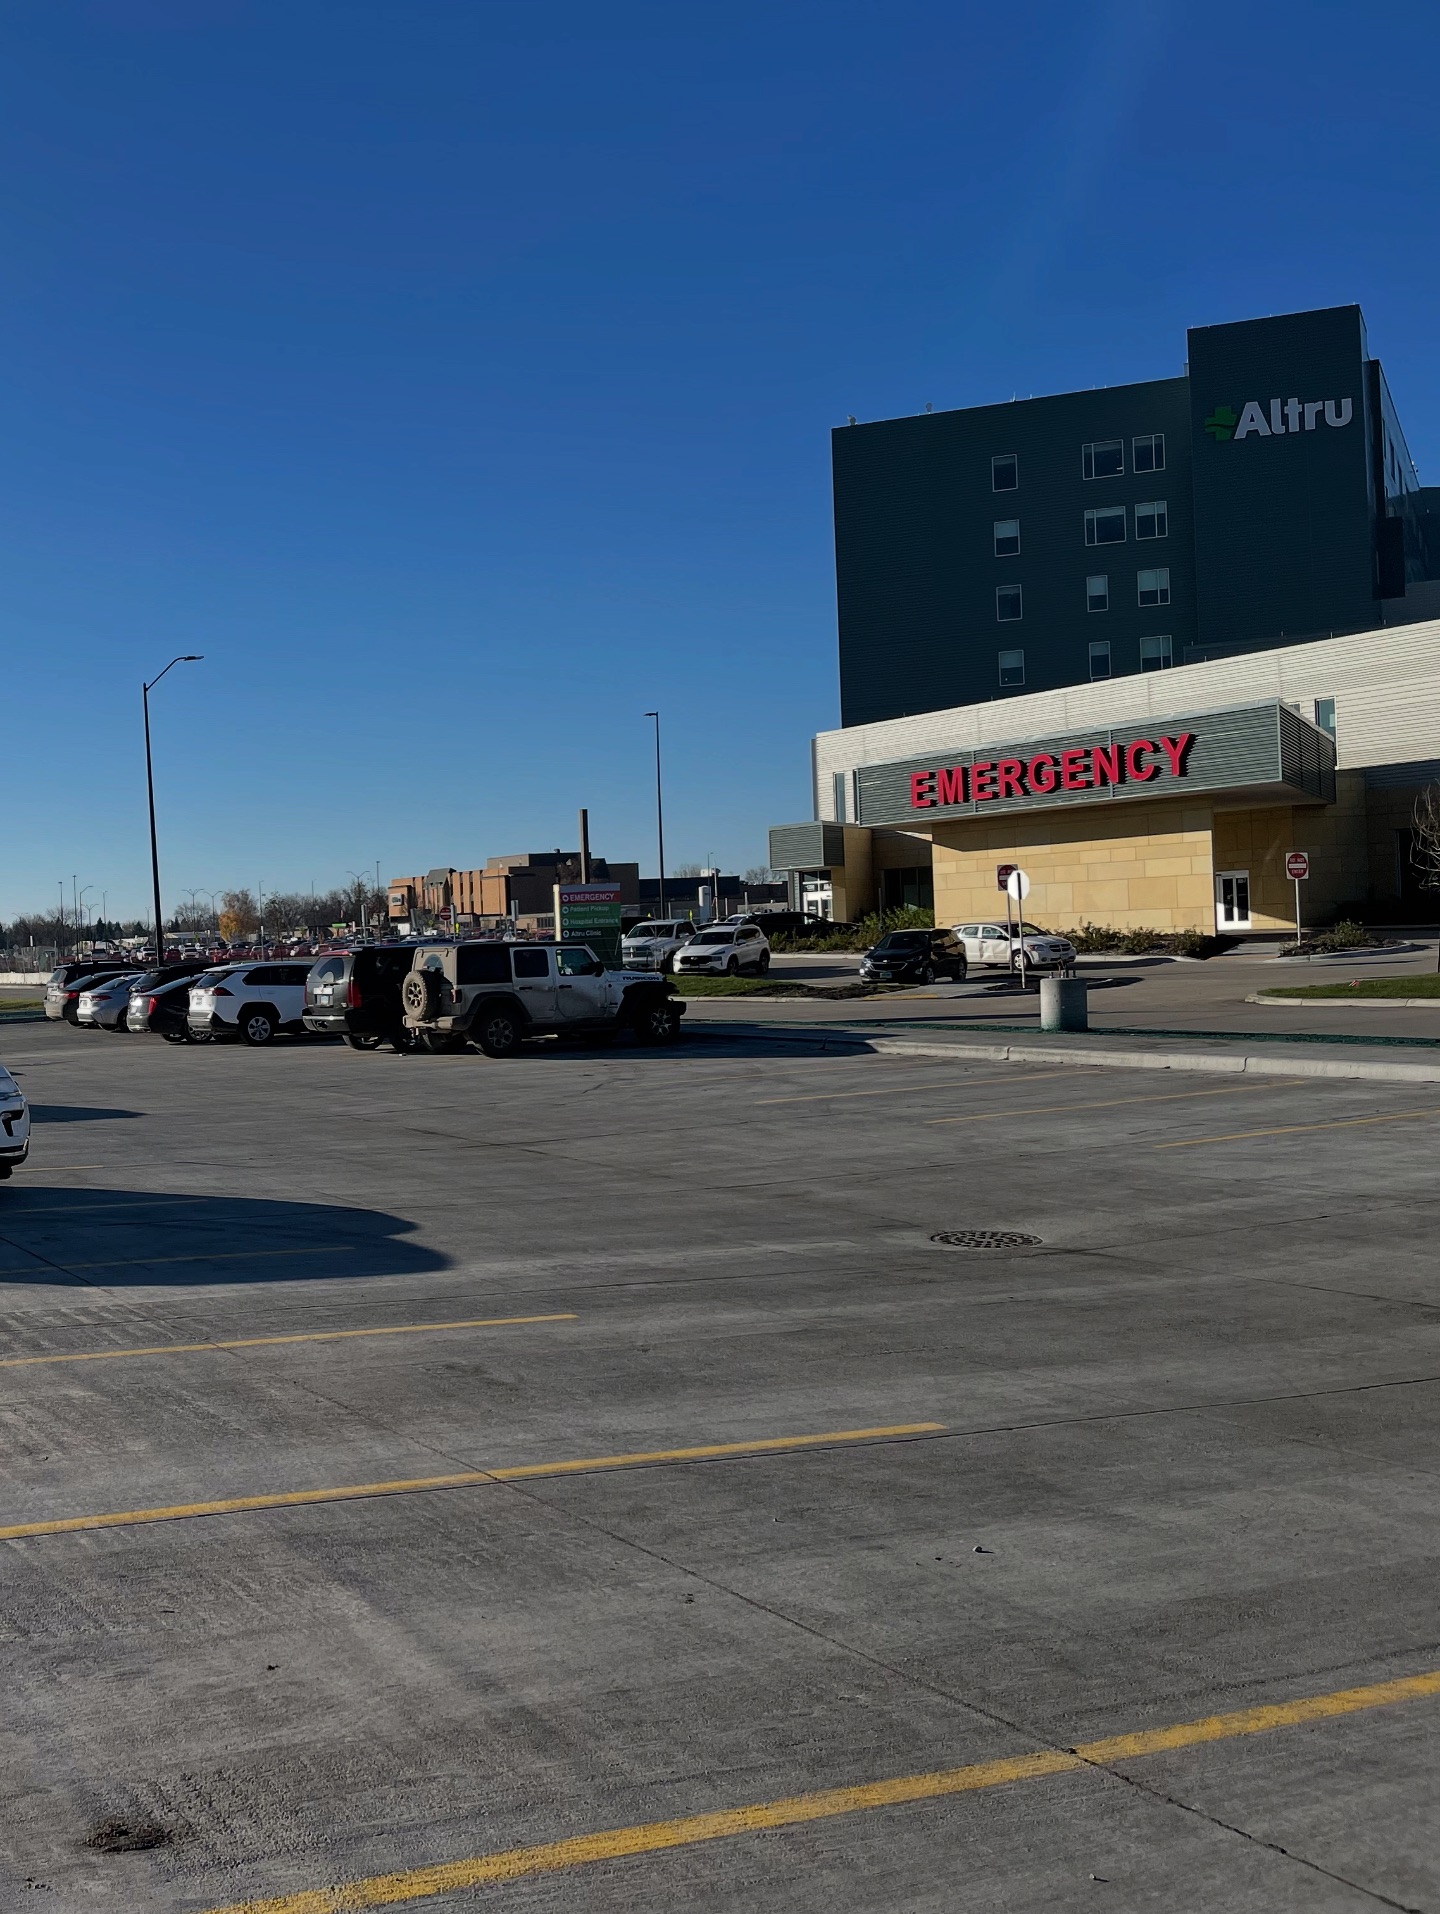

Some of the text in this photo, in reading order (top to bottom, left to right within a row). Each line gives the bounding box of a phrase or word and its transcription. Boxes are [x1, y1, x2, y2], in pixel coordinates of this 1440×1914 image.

[1233, 397, 1353, 440] Altru
[910, 733, 1192, 807] EMERGENCY
[570, 893, 614, 901] EMERGENCY
